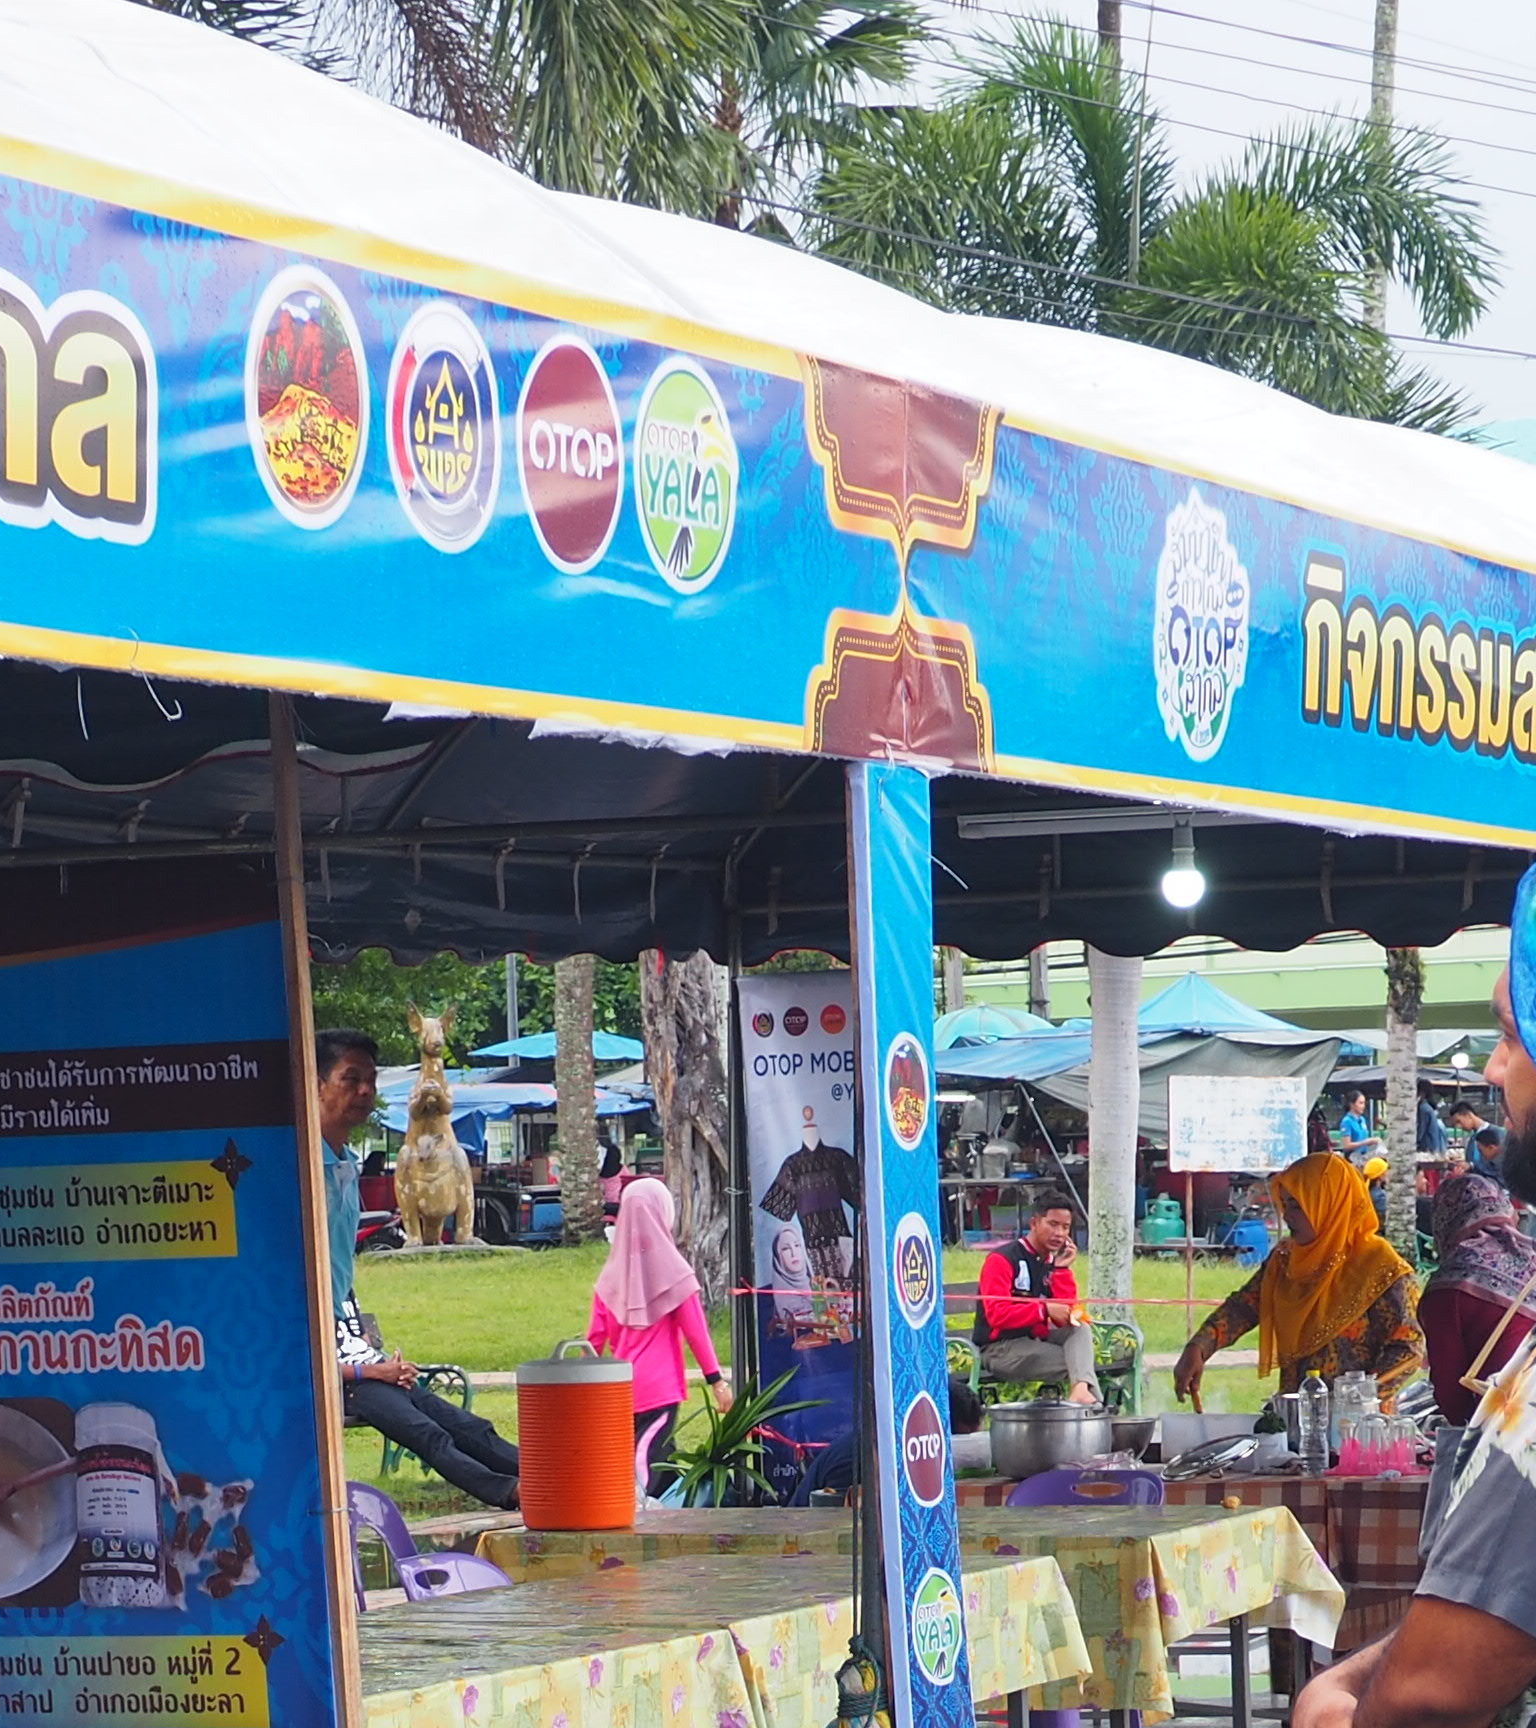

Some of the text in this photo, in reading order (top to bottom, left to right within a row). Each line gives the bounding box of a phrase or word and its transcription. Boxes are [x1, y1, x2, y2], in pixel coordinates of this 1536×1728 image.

[528, 417, 616, 481] OTOP
[647, 420, 691, 454] OTOP
[642, 456, 721, 526] YALA
[753, 1053, 804, 1077] OTOP
[97, 1214, 217, 1247] อำเภอยะหา
[906, 1435, 941, 1463] OTOP
[54, 1644, 157, 1677] บ้านปายอ
[168, 1645, 214, 1687] หมู่ที่
[225, 1646, 242, 1676] 2
[75, 1685, 246, 1715] อำเภอเมืองยะลา
